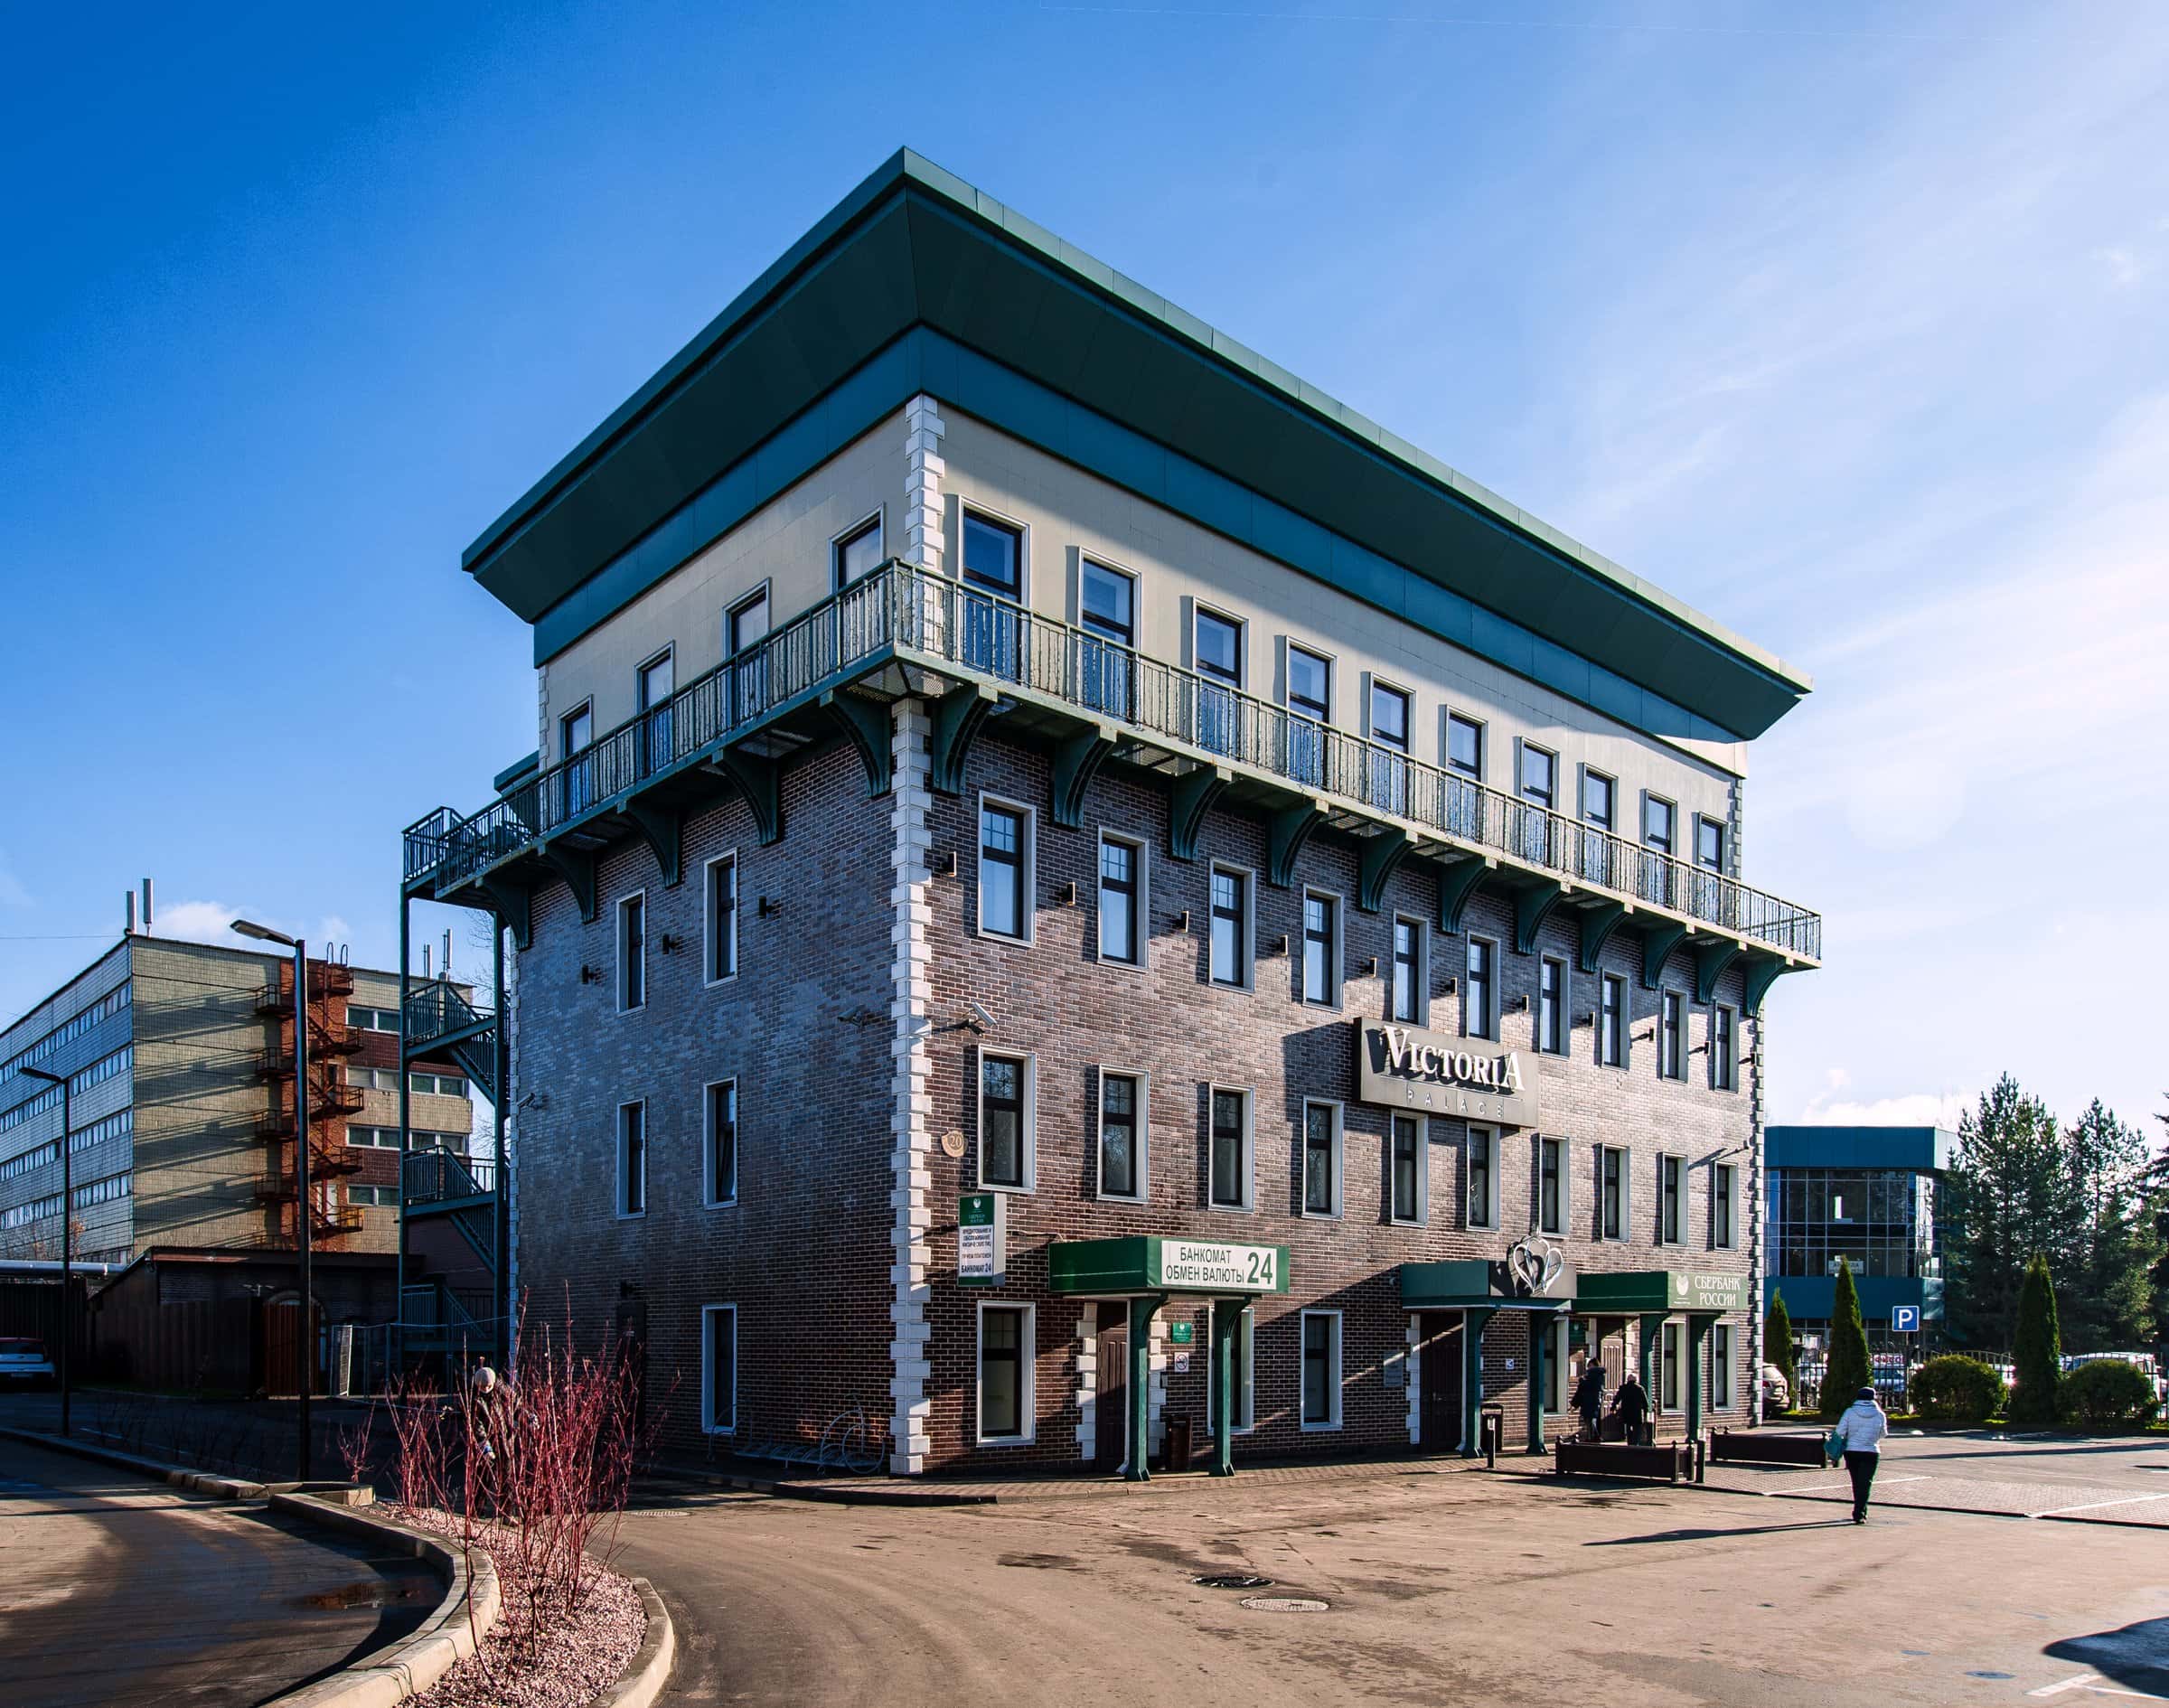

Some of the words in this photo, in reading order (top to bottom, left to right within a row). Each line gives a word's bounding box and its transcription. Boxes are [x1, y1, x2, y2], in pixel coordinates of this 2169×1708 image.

[1384, 1025, 1526, 1091] VICTORIA
[1406, 1089, 1504, 1119] PALACE
[950, 1135, 962, 1149] 20
[1180, 1247, 1232, 1263] БАНКОМАТ
[962, 1265, 984, 1273] БАНКОМАТ
[985, 1263, 991, 1272] 24
[1166, 1265, 1200, 1281] ОБМЕН
[1203, 1267, 1244, 1283] ВАЛЮТЫ
[1247, 1252, 1273, 1284] 24
[1695, 1275, 1741, 1290] СБЕРБАНК
[1699, 1292, 1736, 1307] РОССИИ
[1898, 1309, 1913, 1329] P
